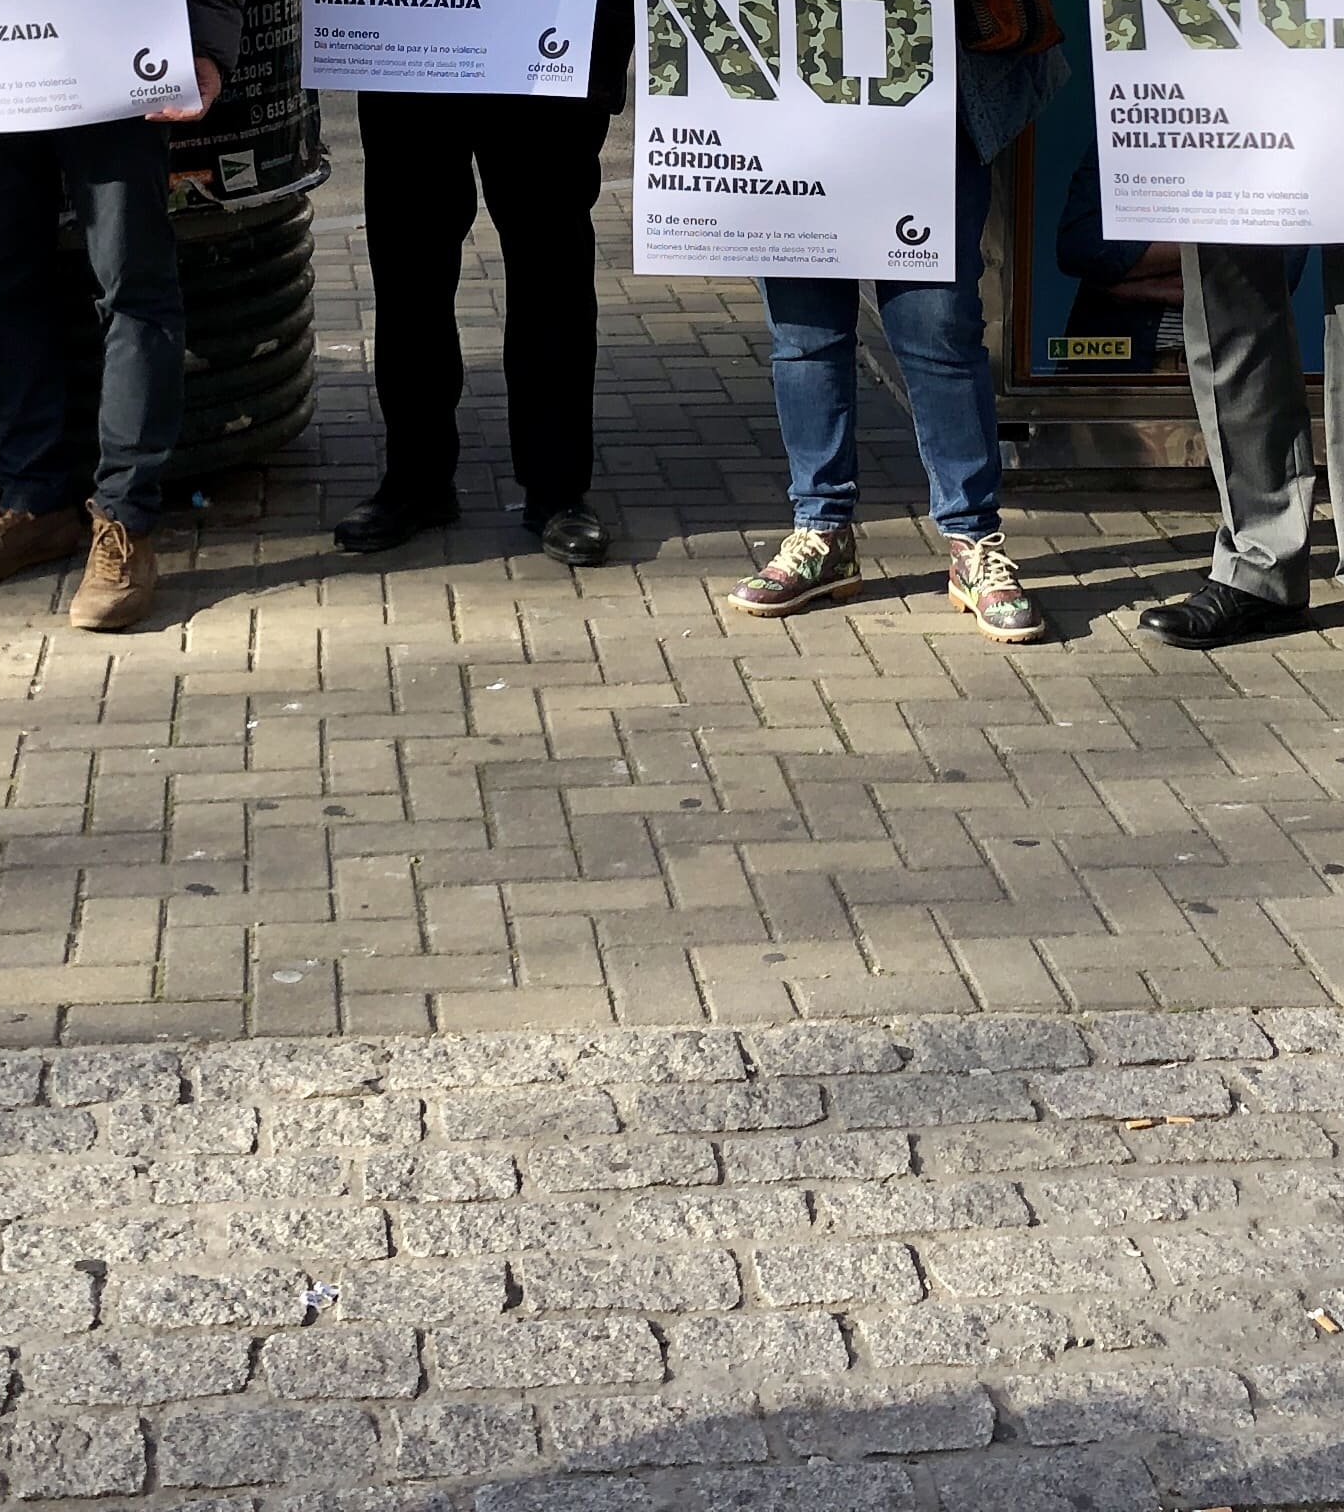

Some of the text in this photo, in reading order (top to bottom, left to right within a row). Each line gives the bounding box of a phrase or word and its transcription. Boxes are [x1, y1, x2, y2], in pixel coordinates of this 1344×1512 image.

[1109, 83, 1185, 100] A UNA
[1110, 103, 1230, 125] CÓRDOBA
[648, 127, 722, 146] A UNA
[1112, 131, 1295, 150] MILITARIZADA
[649, 146, 763, 172] CÓRDOBA
[647, 174, 826, 196] MILITARIZADA
[1072, 341, 1126, 354] ONCE
